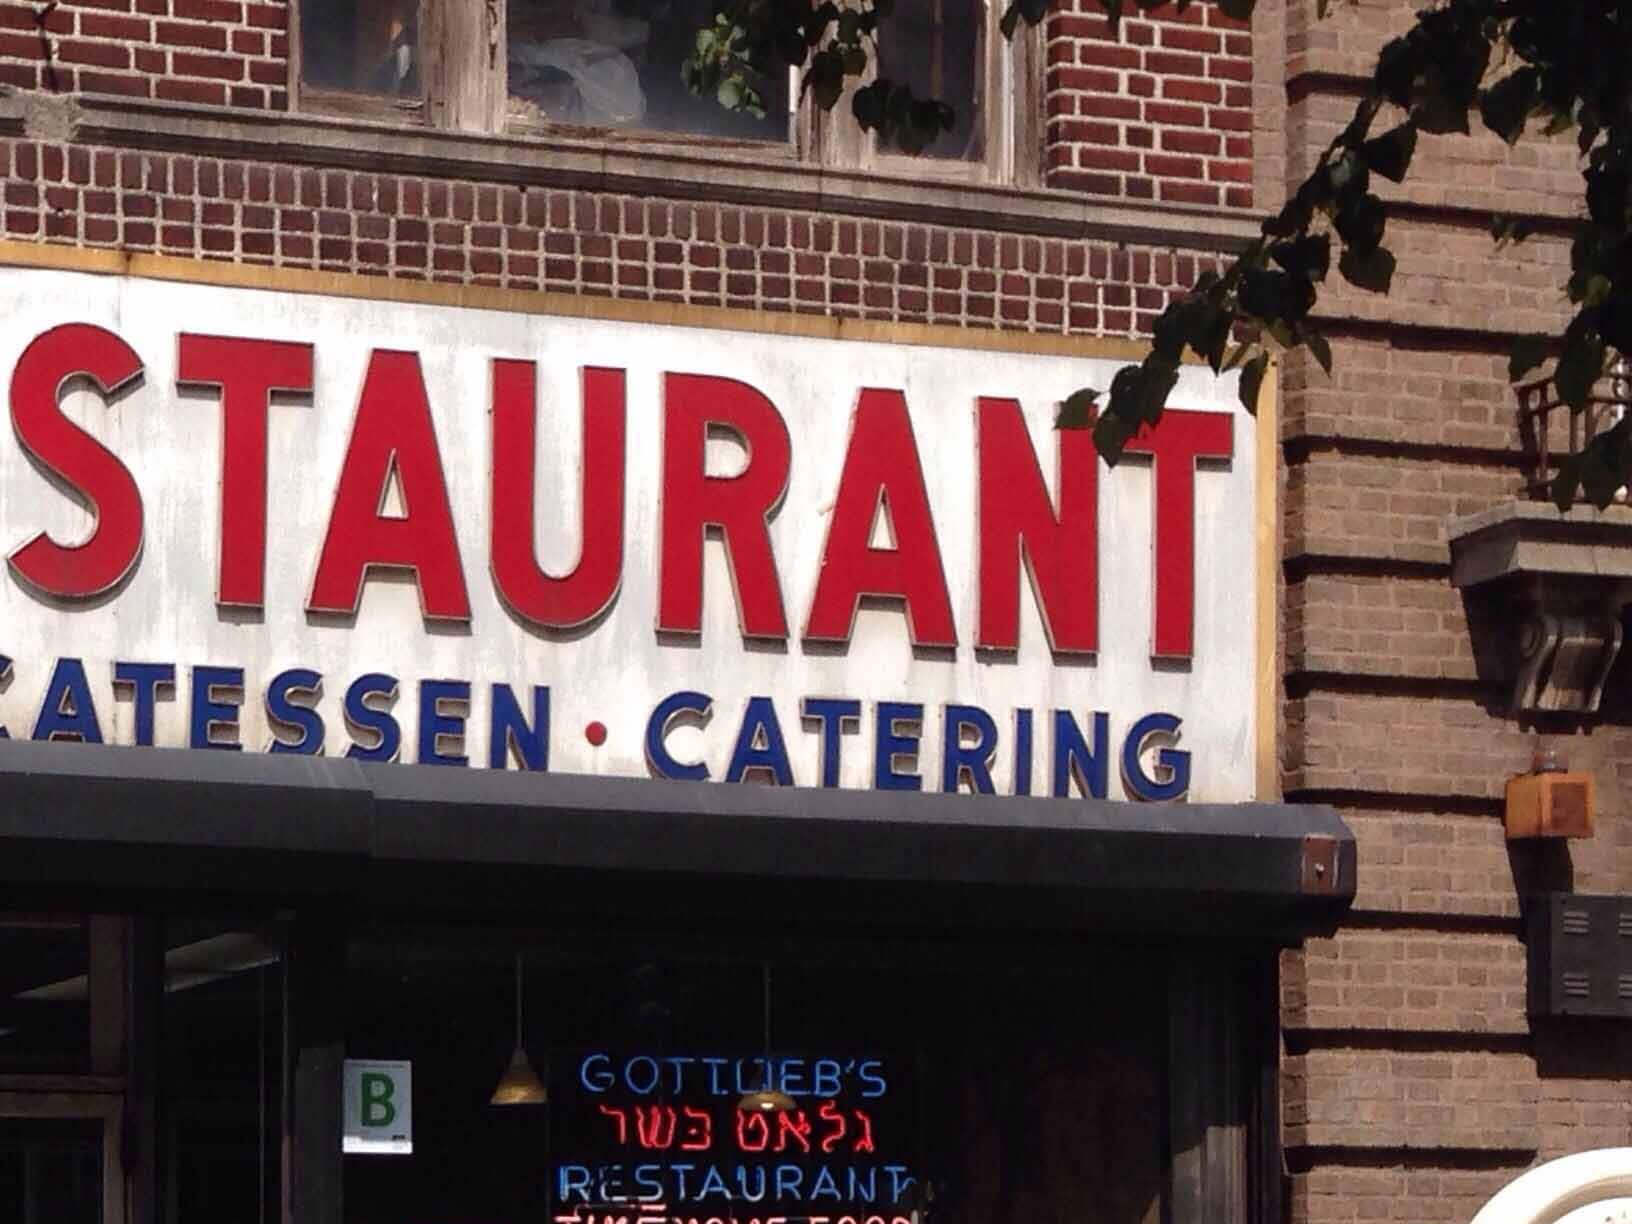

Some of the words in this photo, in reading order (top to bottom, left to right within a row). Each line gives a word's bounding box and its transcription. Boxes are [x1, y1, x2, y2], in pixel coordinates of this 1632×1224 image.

[644, 690, 1193, 801] CATERING
[361, 1071, 396, 1127] B
[580, 1054, 888, 1098] GOTTLIEB'S
[559, 1164, 914, 1203] RESTAURANT
